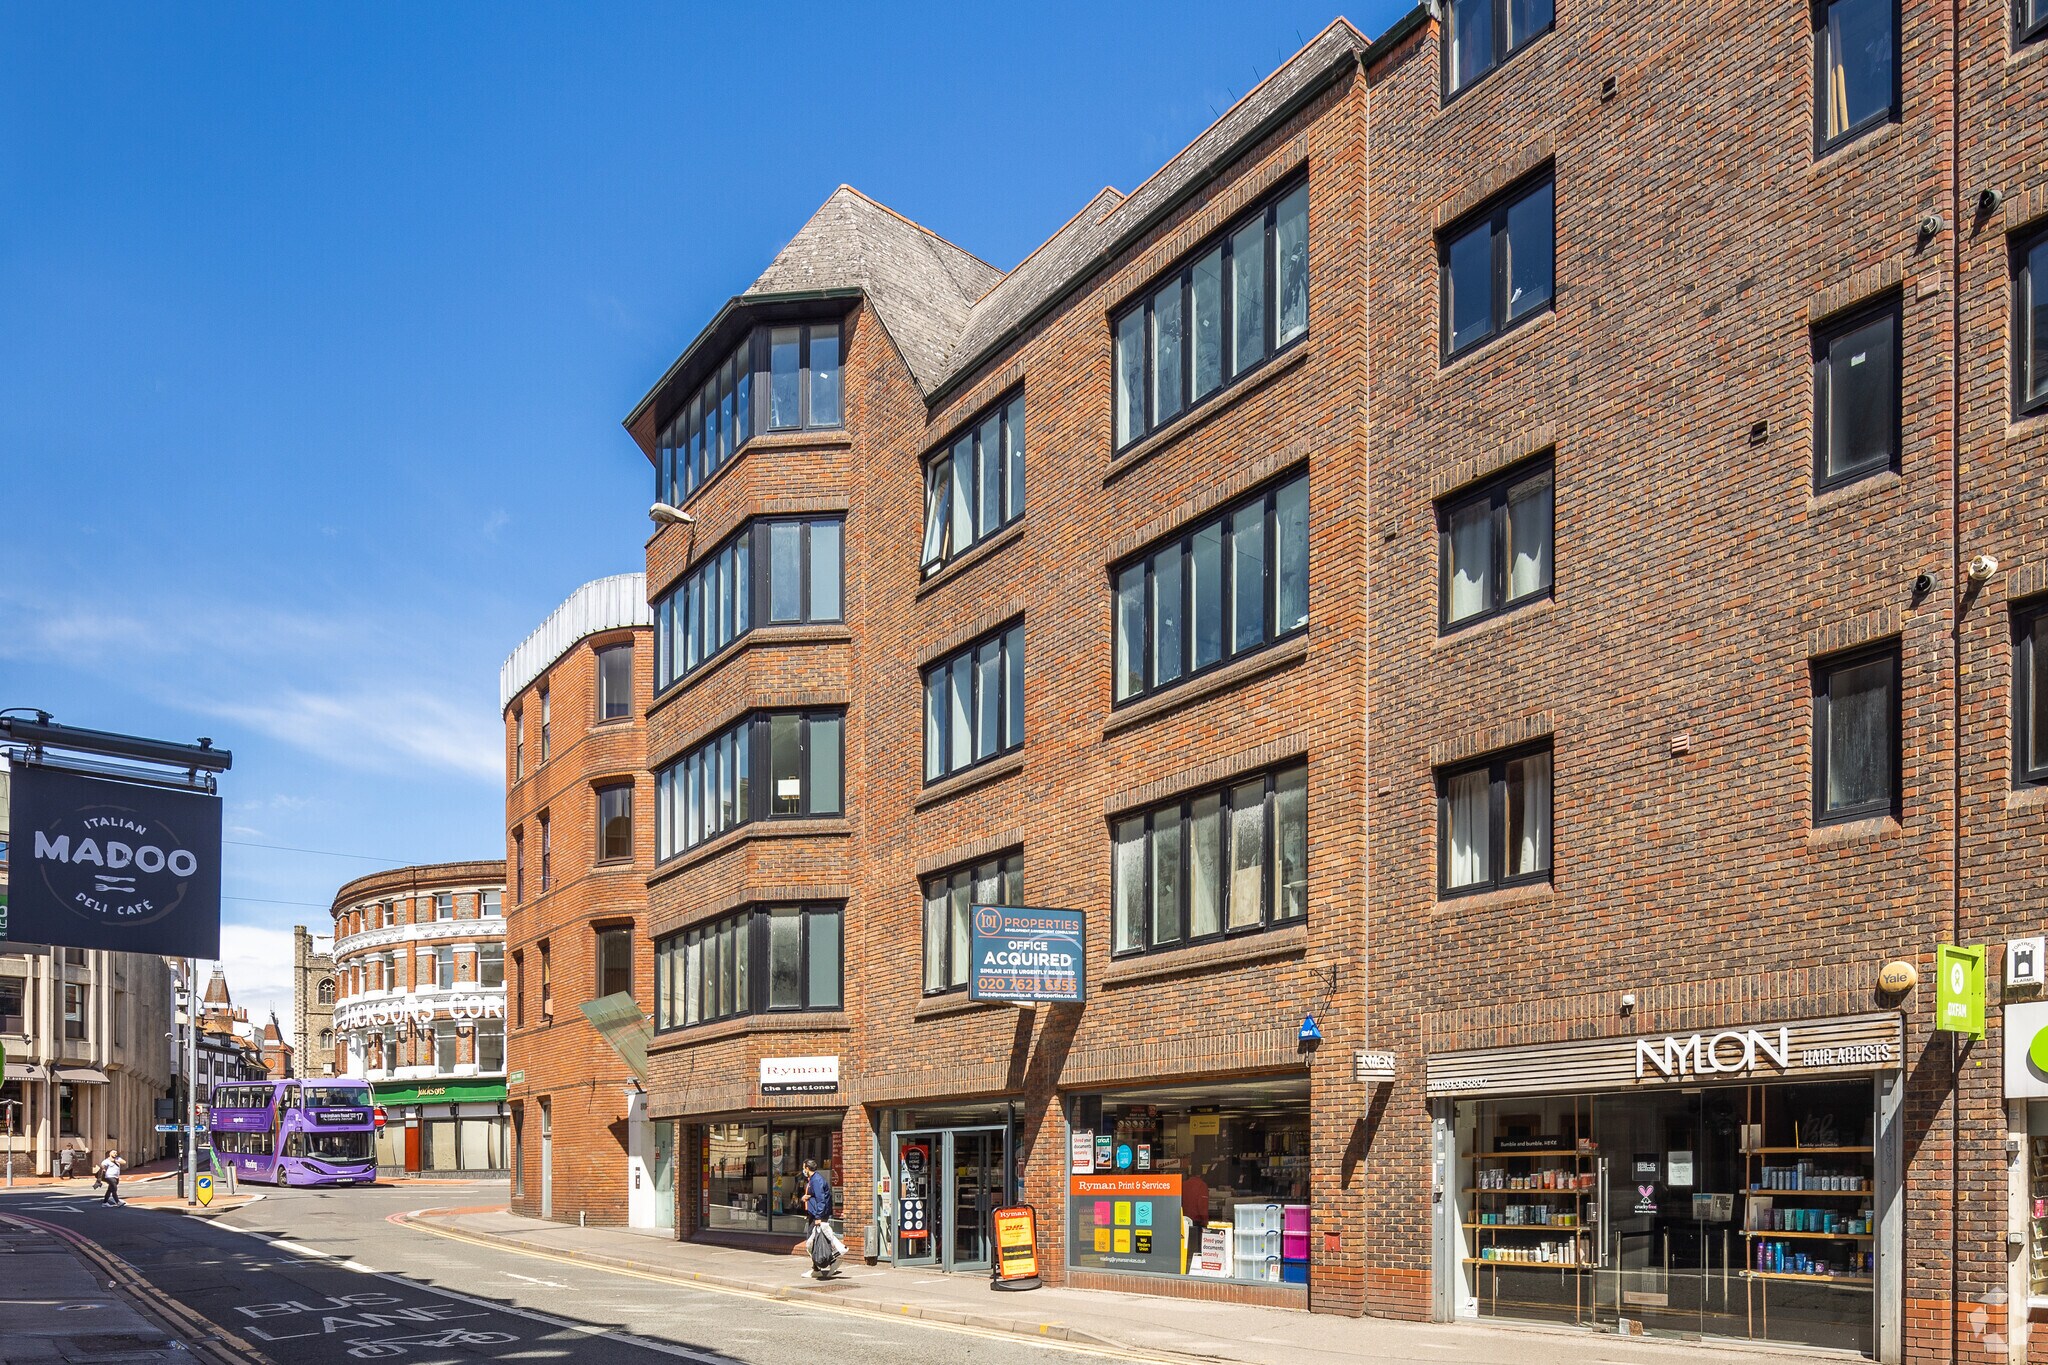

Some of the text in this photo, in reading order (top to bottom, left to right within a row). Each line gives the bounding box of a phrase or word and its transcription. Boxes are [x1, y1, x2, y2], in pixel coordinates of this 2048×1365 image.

[84, 817, 147, 835] ITALIAN
[34, 830, 198, 877] MADOO
[75, 892, 154, 915] DELI CAFÉ
[1004, 918, 1079, 930] PROPERTIES
[1007, 940, 1048, 951] OFFICE
[2012, 941, 2037, 952] FORTRESS
[983, 951, 1072, 967] ACQUIRED
[978, 978, 1006, 990] 020
[1883, 972, 1908, 984] Yale
[342, 992, 507, 1029] JACKSONS COR
[1947, 1002, 1967, 1018] OXFAM
[1636, 1026, 1788, 1078] NYLON
[1803, 1043, 1891, 1067] HAIR ARTISTS
[767, 1066, 833, 1076] Ryman
[417, 1085, 446, 1099] Jacksons
[356, 1112, 364, 1121] 17
[1078, 1181, 1170, 1191] Ryman Print & Services
[234, 1293, 403, 1318] BUS
[244, 1304, 490, 1341] LANE
